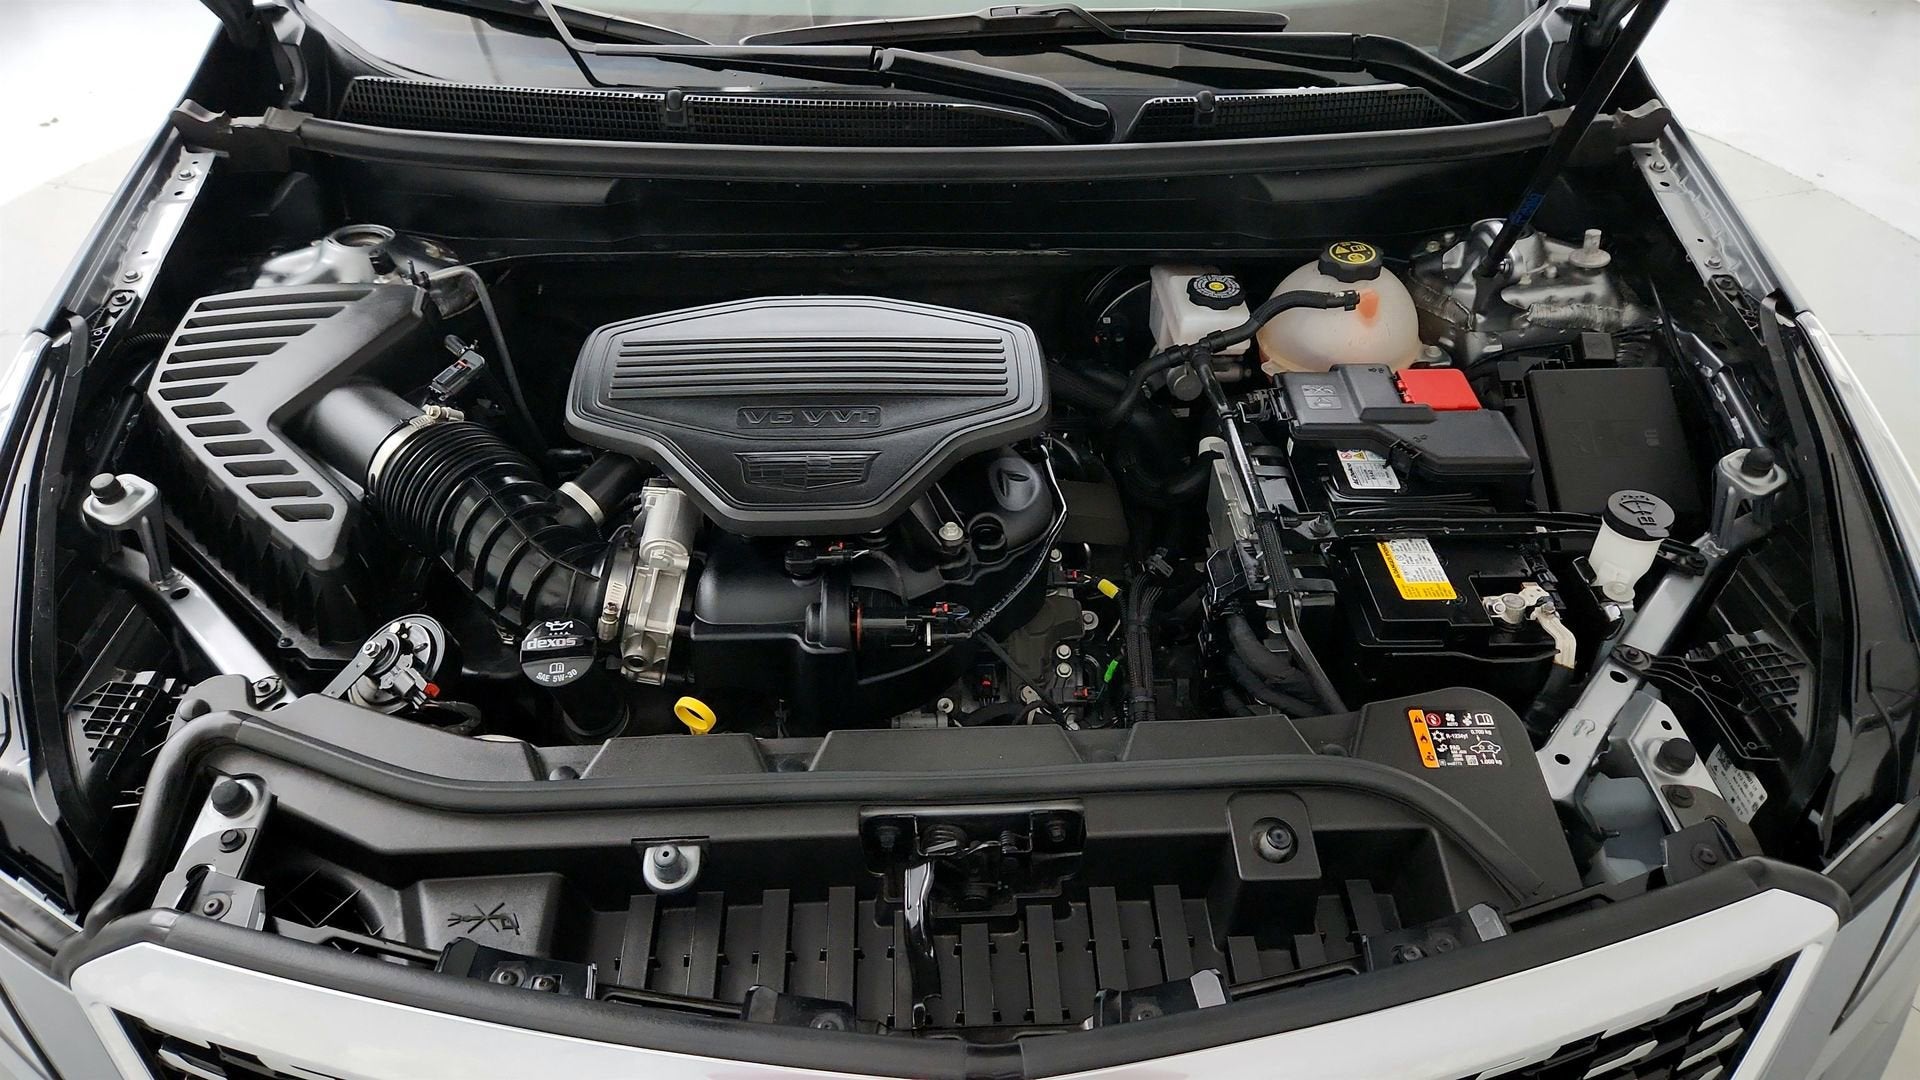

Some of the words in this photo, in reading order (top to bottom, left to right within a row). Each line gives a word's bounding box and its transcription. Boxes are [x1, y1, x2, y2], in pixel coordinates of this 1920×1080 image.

[743, 410, 793, 424] V6
[801, 409, 877, 425] VVT
[526, 637, 576, 650] dexos
[536, 672, 550, 682] SAE
[552, 668, 578, 682] 5W-30
